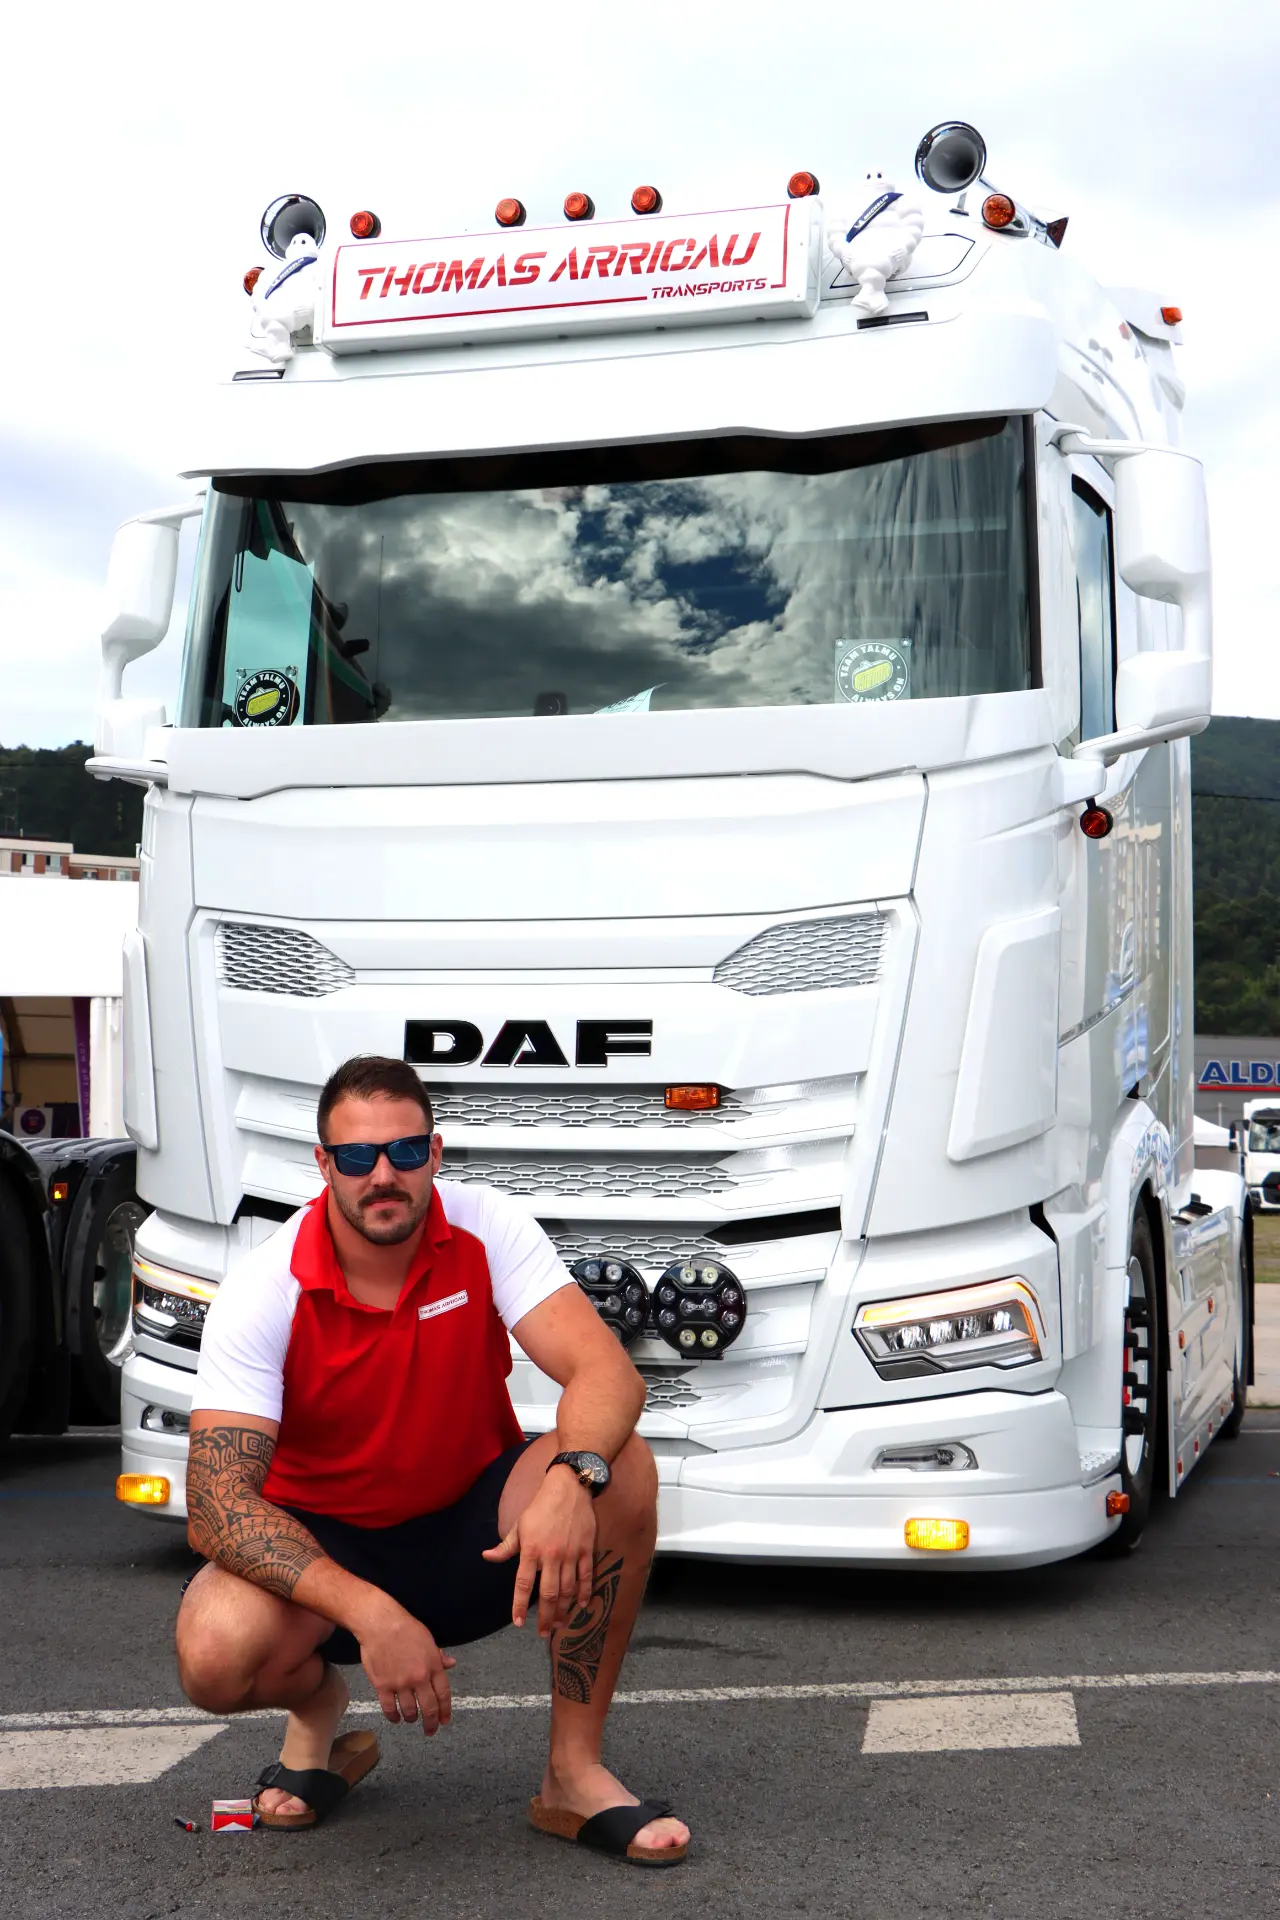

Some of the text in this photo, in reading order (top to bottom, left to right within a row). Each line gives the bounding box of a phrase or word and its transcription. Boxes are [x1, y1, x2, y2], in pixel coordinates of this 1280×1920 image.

[358, 232, 762, 300] THOMAS ARRICAU
[651, 278, 768, 299] TRANSPORTS
[840, 645, 897, 678] TEAM TALMU
[239, 673, 286, 701] TEAM TALMU
[893, 677, 905, 692] ON
[275, 705, 287, 719] ON
[403, 1019, 653, 1068] DAF
